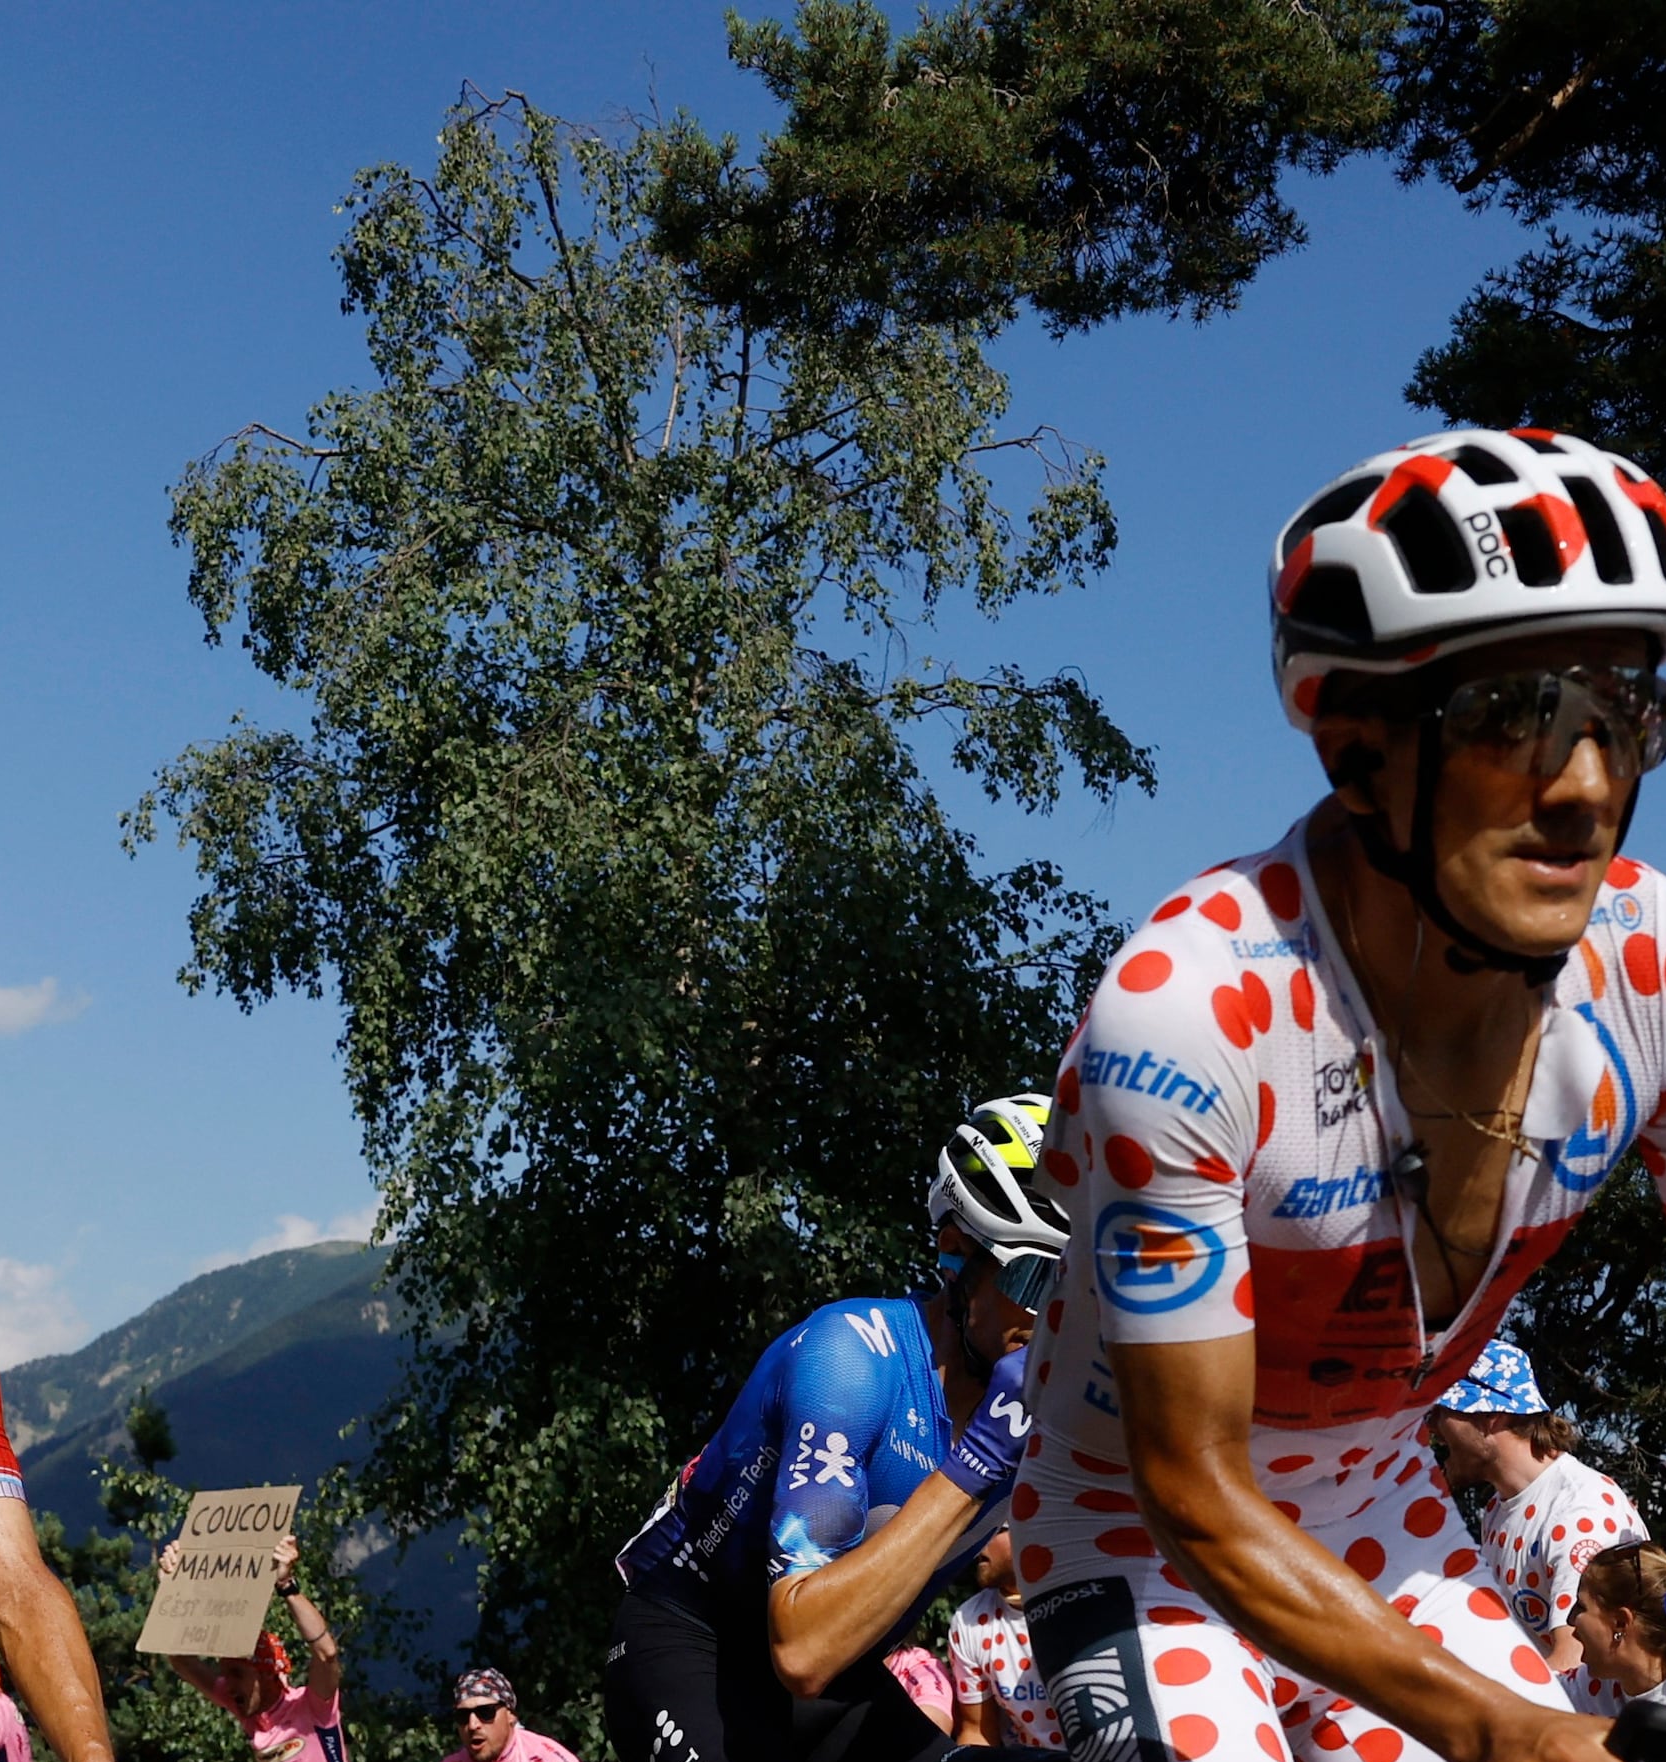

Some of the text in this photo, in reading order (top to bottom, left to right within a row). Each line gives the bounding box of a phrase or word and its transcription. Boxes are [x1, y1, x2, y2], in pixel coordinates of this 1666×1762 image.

[1463, 511, 1508, 579] poc
[789, 1422, 816, 1491] vivo
[191, 1502, 291, 1537] COUCOU
[696, 1443, 780, 1559] Telefónica Tech
[172, 1553, 265, 1581] MAMAN
